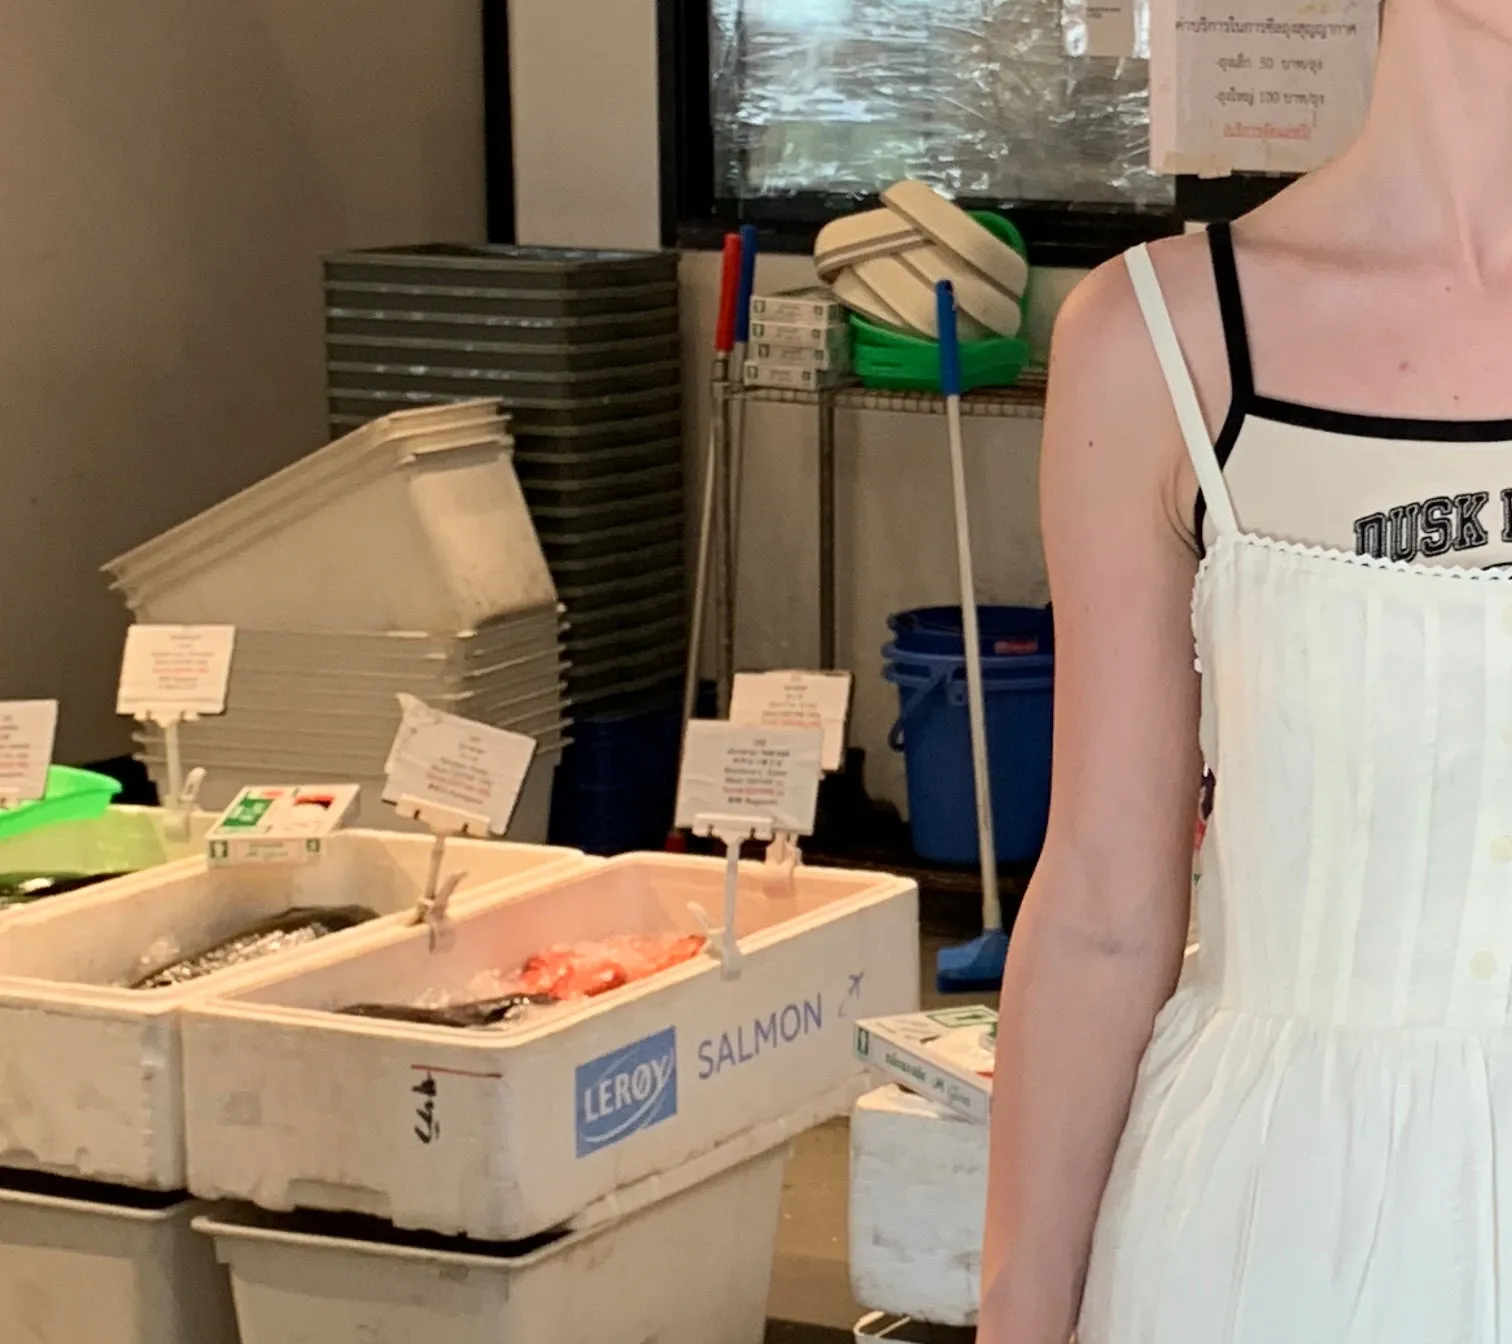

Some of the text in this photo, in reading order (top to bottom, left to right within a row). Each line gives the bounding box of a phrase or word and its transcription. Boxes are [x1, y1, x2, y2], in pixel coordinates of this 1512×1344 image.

[1354, 491, 1489, 563] DUSK
[698, 993, 822, 1080] SALMON
[583, 1059, 672, 1123] LERØY
